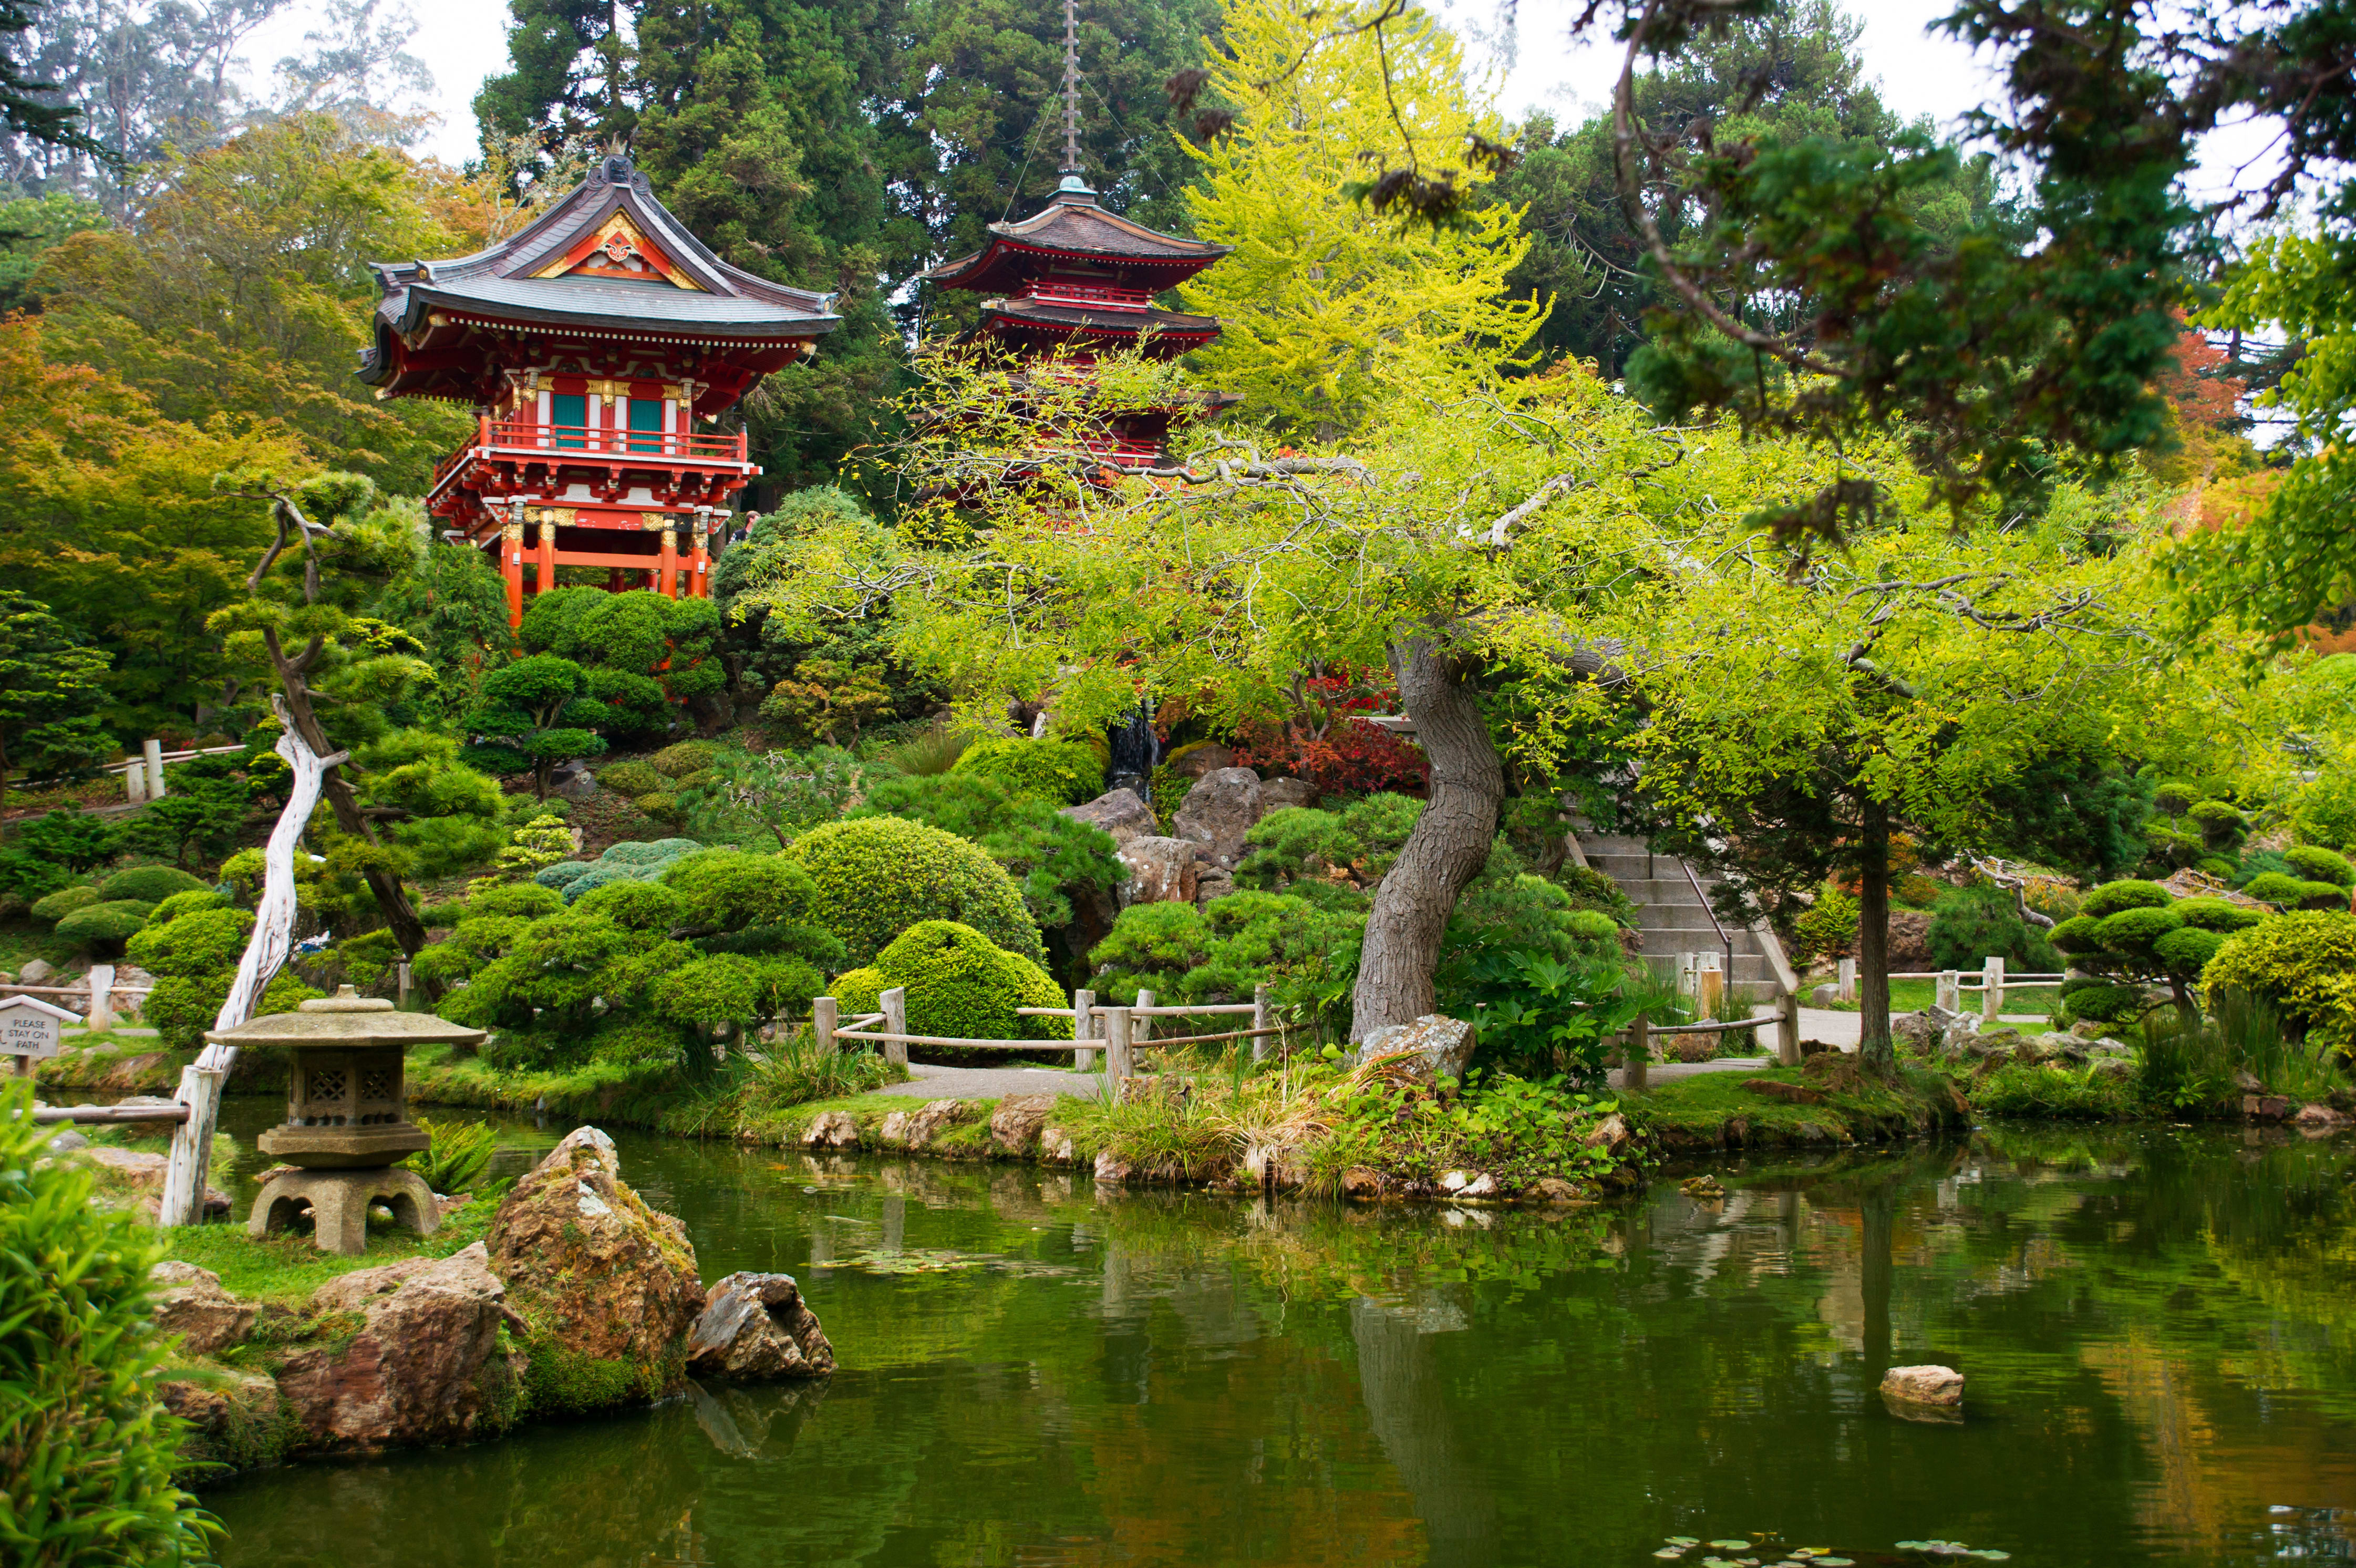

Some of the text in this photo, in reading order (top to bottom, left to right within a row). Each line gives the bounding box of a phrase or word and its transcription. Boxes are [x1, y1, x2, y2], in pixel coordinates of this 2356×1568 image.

[14, 1019, 46, 1028] PLEASE
[8, 1029, 30, 1038] STAY
[16, 1040, 39, 1049] PATH
